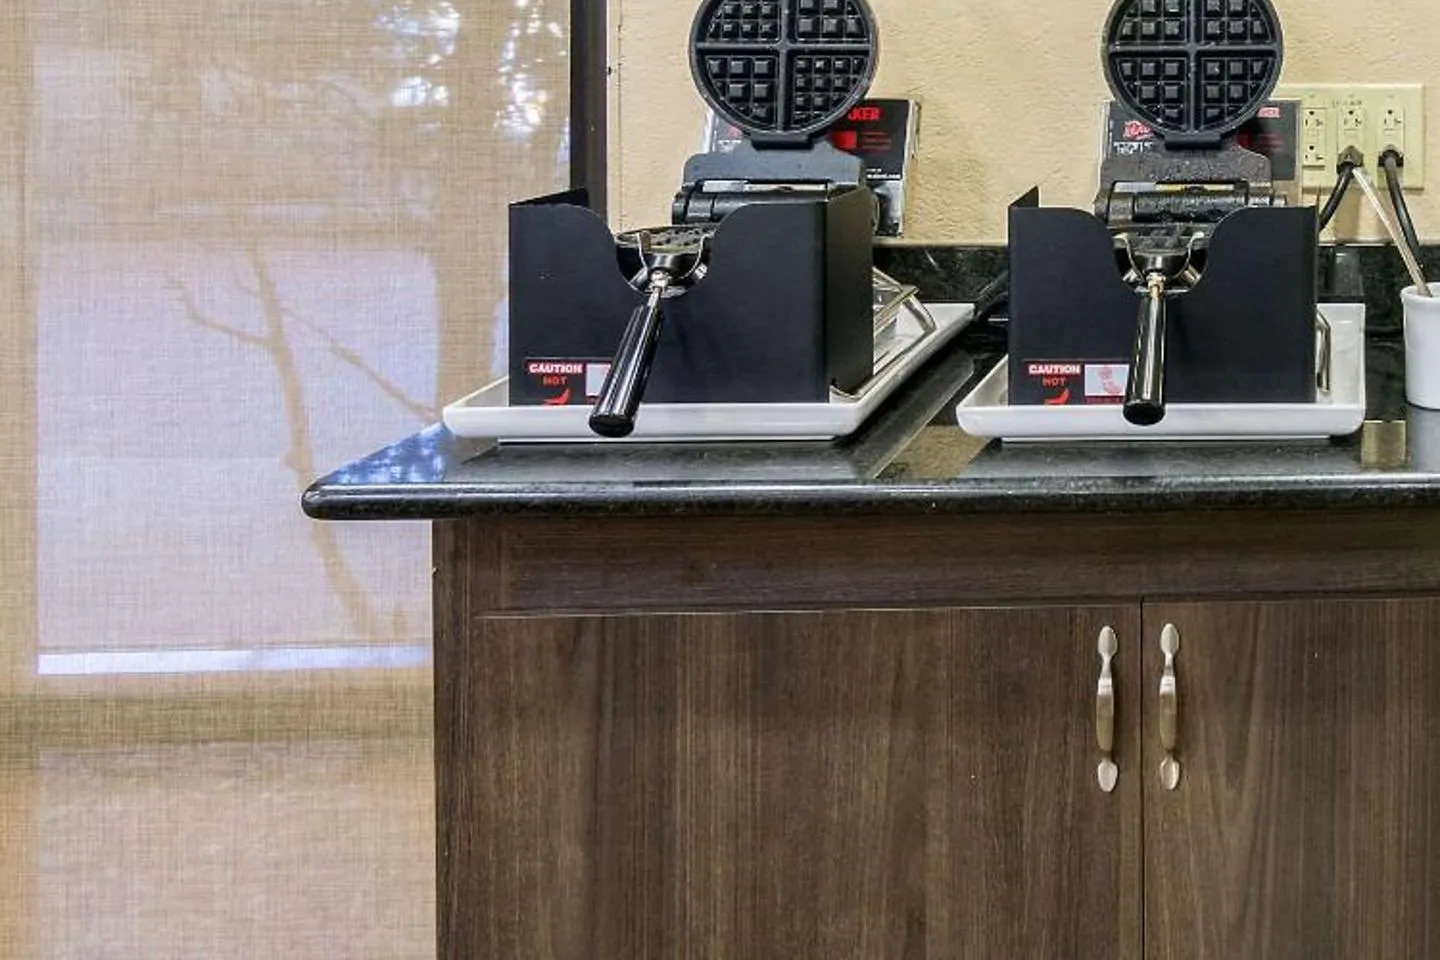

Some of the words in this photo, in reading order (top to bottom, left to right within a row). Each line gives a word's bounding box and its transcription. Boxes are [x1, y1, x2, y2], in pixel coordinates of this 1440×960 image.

[529, 362, 583, 374] CAUTION
[1028, 363, 1080, 375] CAUTION
[543, 375, 567, 386] HOT
[1042, 377, 1066, 386] HOT
